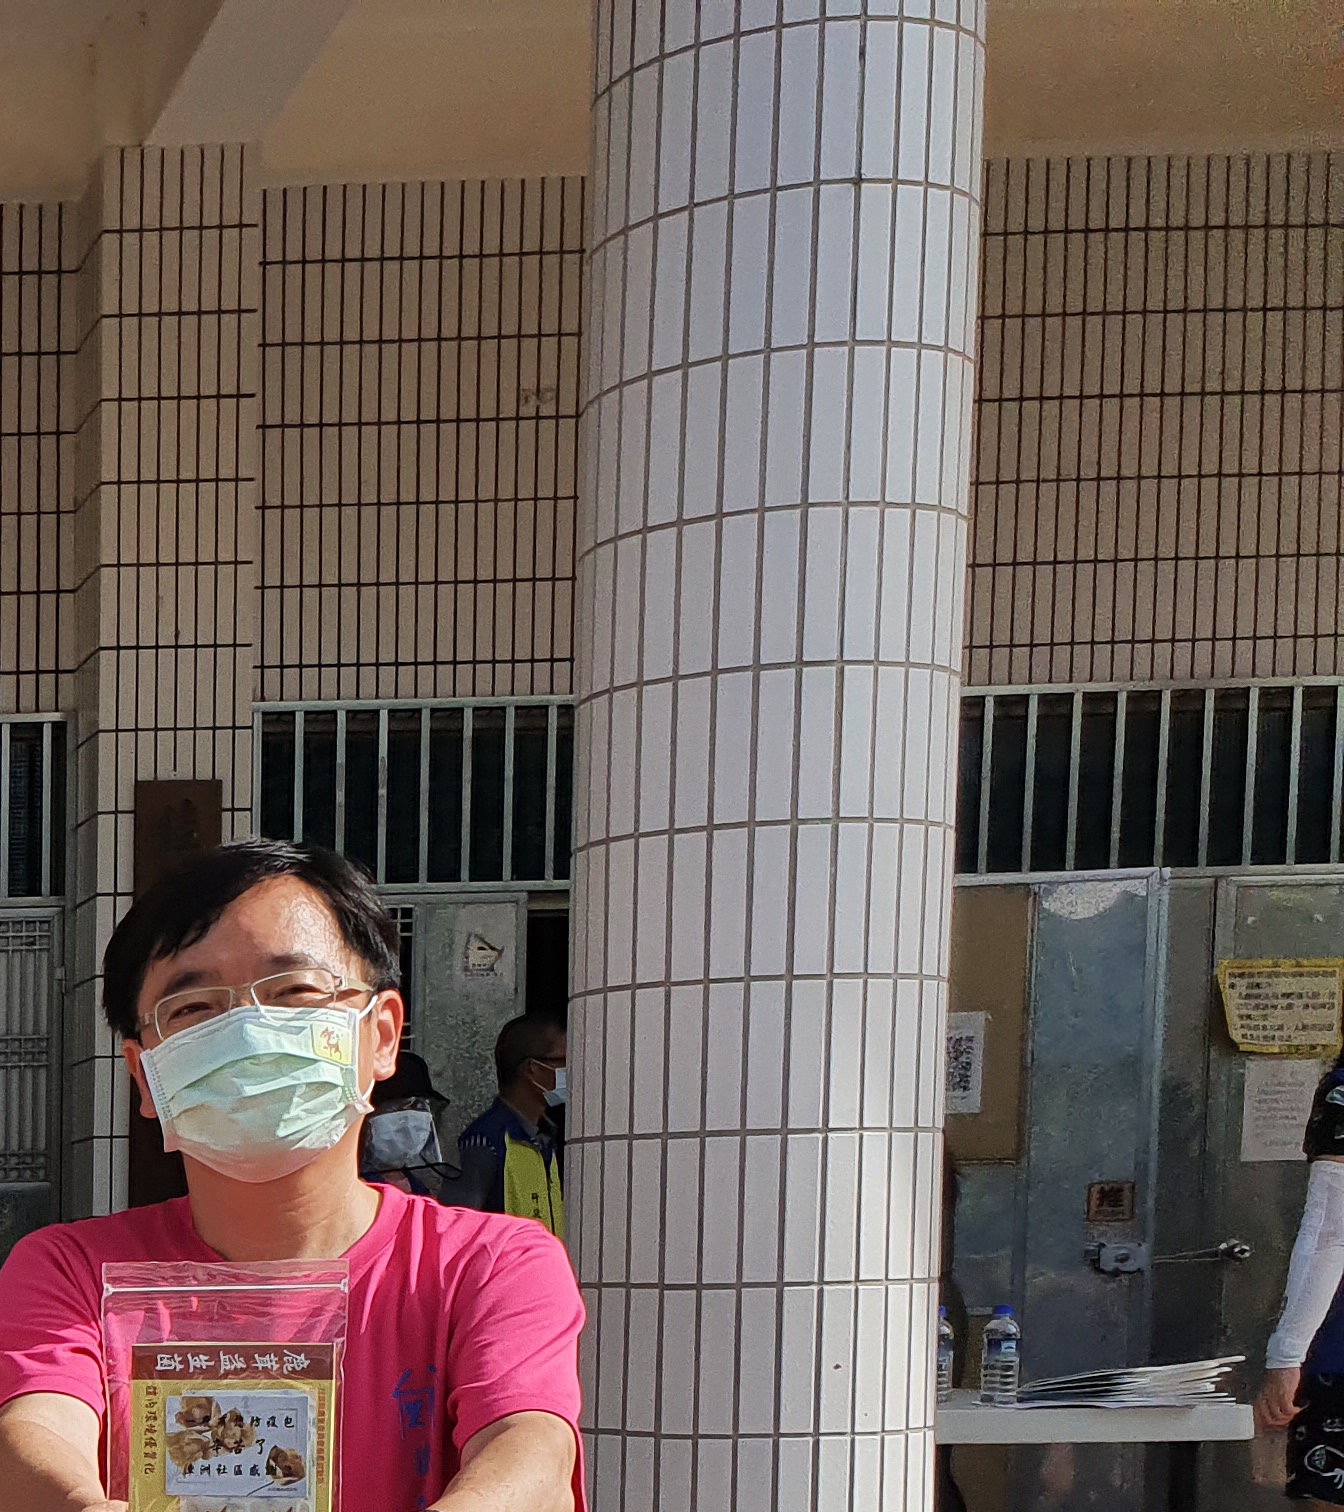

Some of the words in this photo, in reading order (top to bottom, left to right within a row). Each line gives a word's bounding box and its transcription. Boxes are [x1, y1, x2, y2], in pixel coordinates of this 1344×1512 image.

[155, 1349, 310, 1374] 鹿茸益生菌
